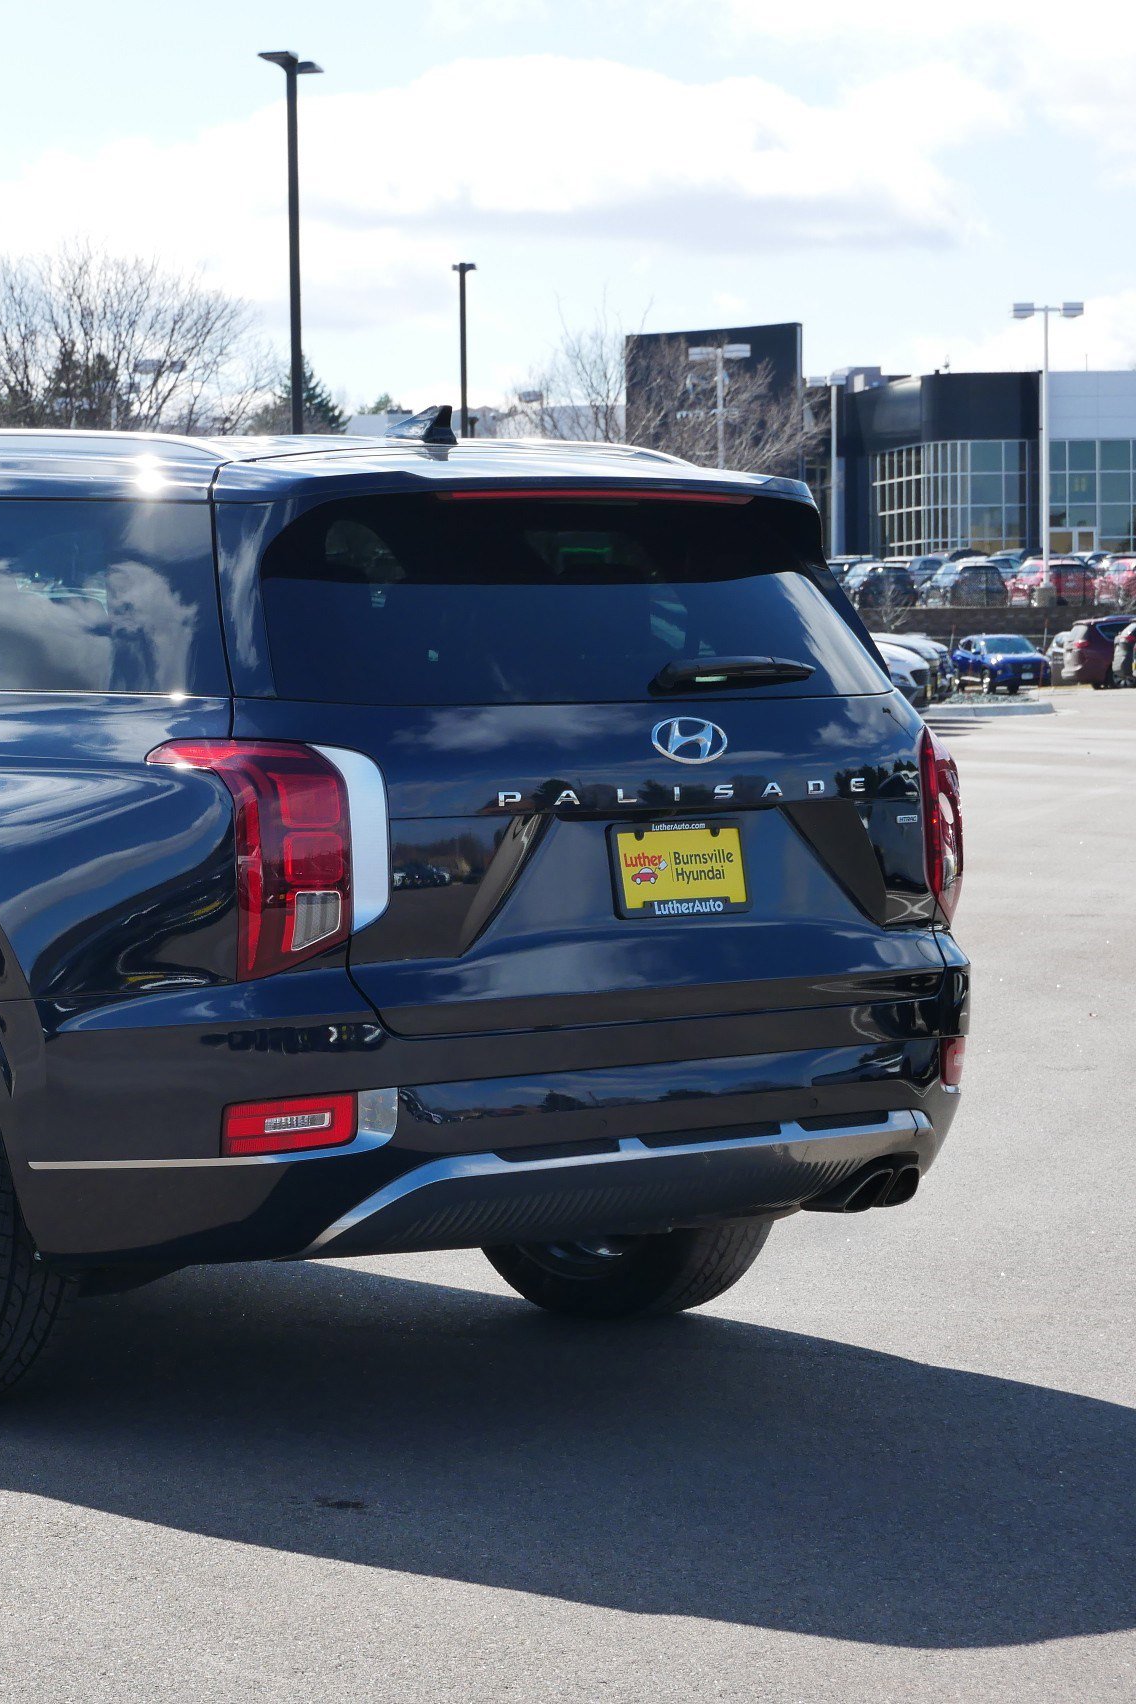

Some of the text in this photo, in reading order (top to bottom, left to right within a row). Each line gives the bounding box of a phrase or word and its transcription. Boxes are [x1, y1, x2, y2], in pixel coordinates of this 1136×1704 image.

[498, 777, 866, 807] PALISADE
[651, 822, 706, 832] LutherAuto.com
[623, 852, 663, 868] Luther
[673, 849, 734, 866] Burnsville
[675, 865, 726, 884] Hyundai
[653, 899, 724, 915] LutherAuto
